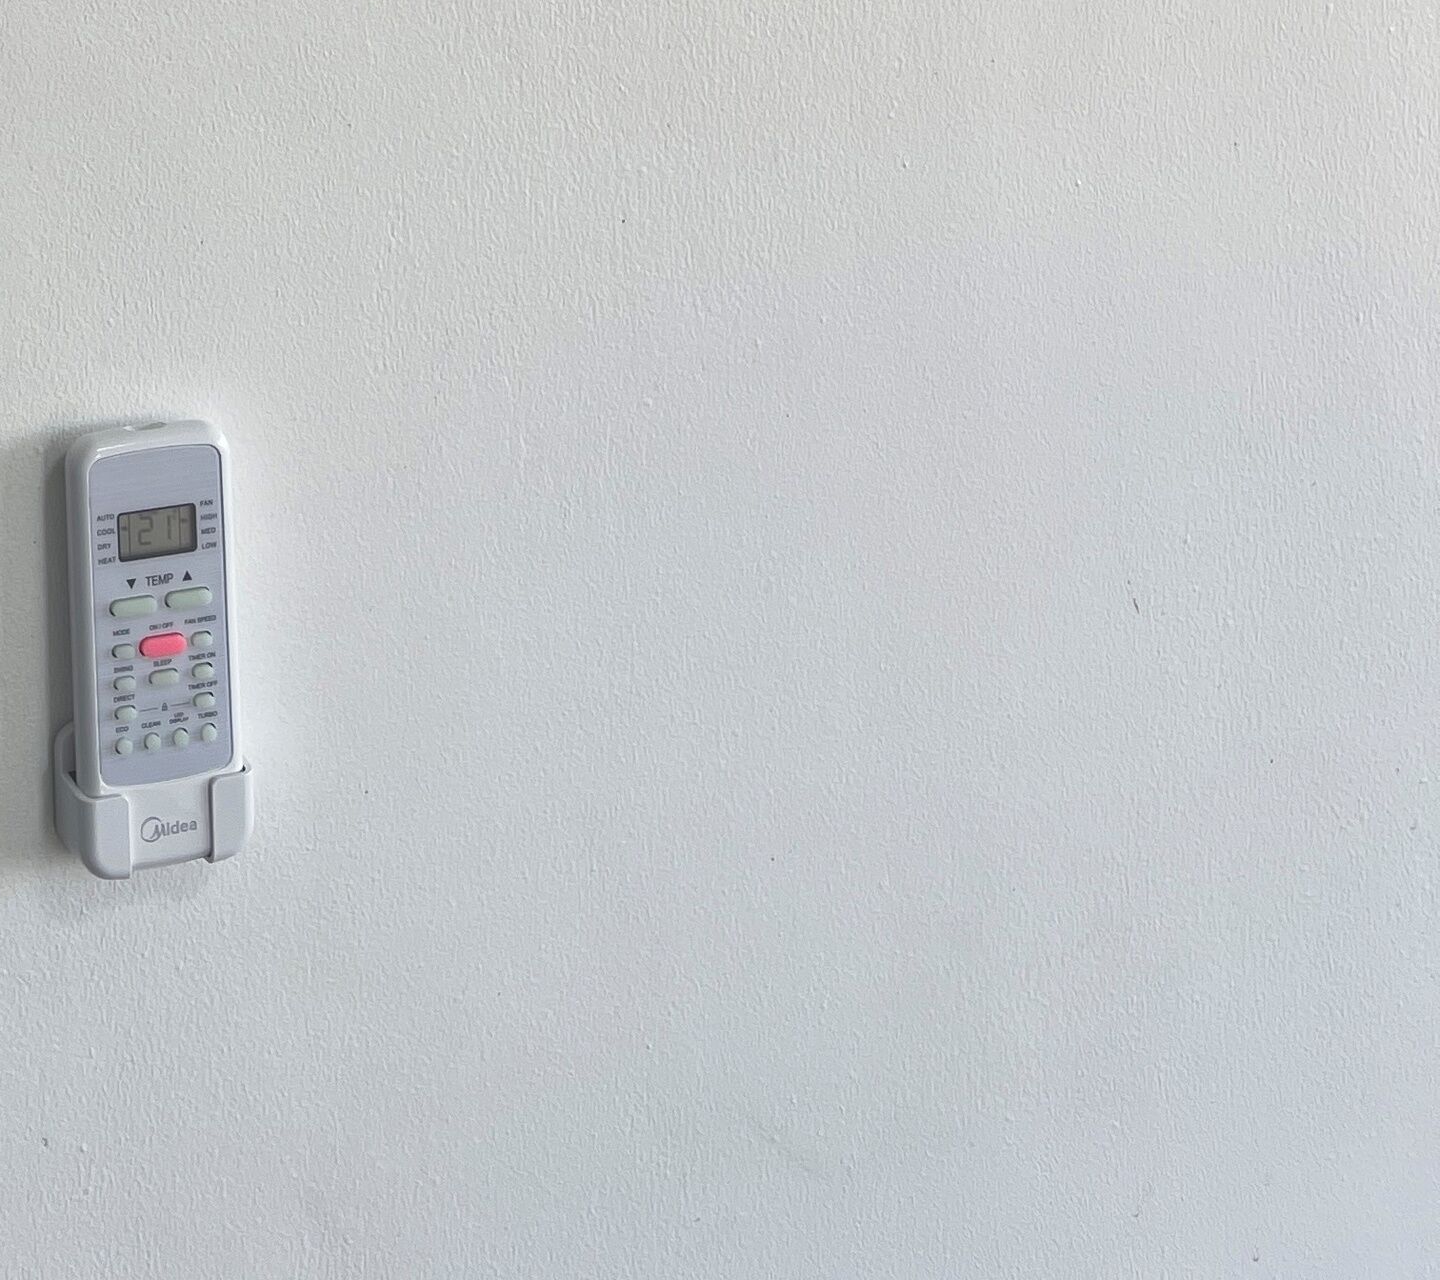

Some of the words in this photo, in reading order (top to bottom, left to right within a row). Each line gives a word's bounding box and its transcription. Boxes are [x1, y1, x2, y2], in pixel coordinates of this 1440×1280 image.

[97, 528, 116, 536] COOL
[98, 556, 116, 565] HEAT
[146, 573, 174, 586] TEMP
[198, 615, 216, 623] SPEED
[153, 659, 172, 667] SLEEP
[188, 682, 206, 690] TIMER
[206, 680, 218, 688] OFF
[113, 694, 135, 703] DIRECT
[198, 711, 218, 719] TURBO
[141, 817, 197, 842] Midea
